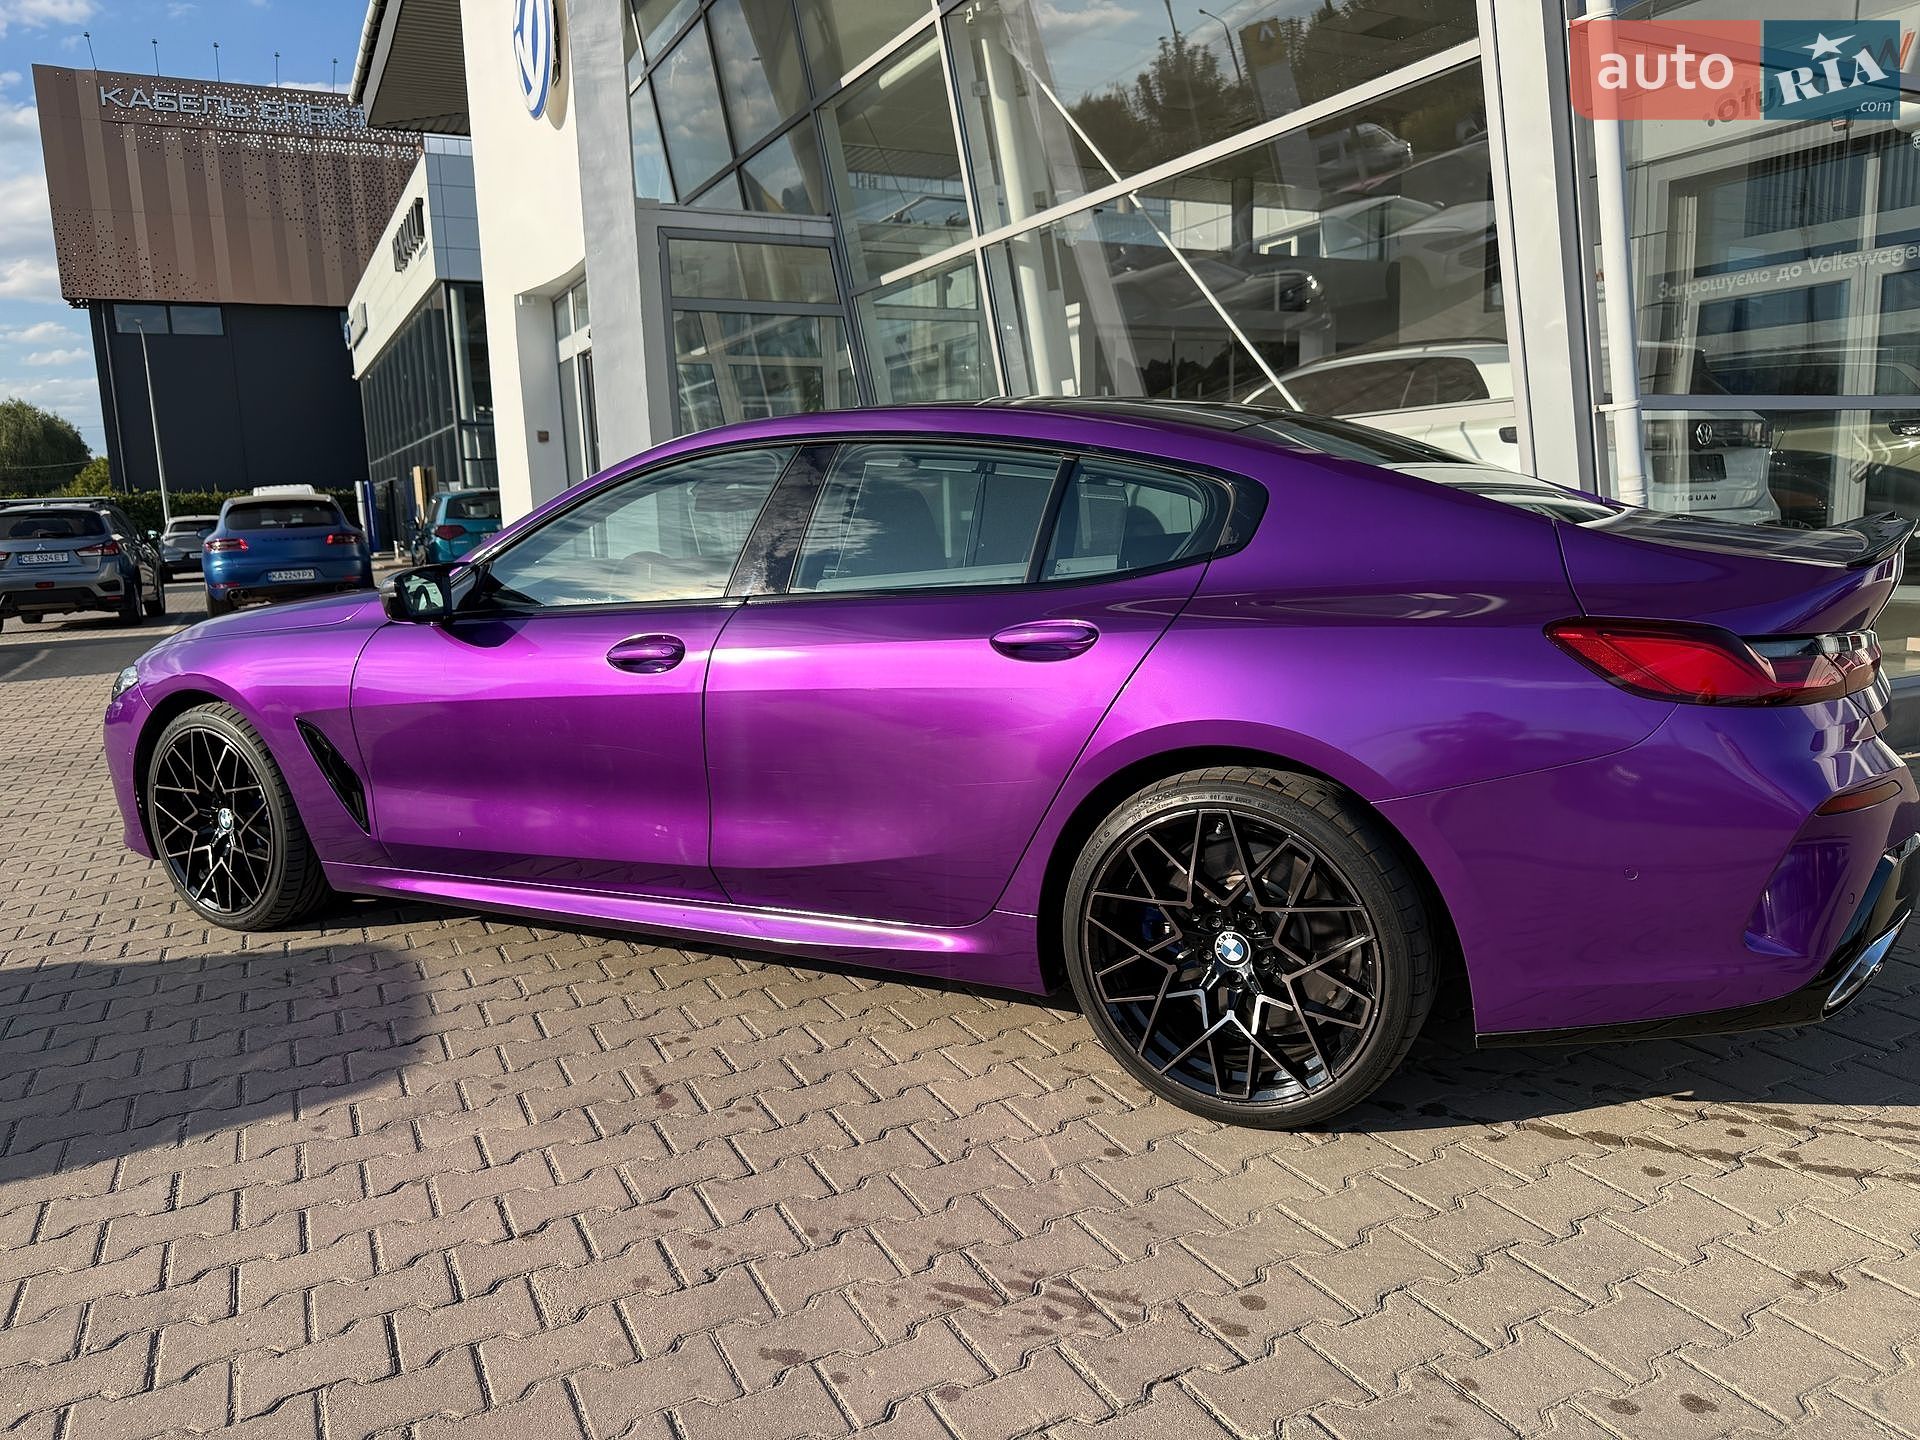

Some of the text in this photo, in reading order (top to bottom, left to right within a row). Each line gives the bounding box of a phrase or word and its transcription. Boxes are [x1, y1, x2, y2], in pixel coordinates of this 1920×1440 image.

[100, 85, 250, 118] КАБЕЛЬ
[1657, 244, 1920, 300] Запрошуємо до Volkswage
[1673, 494, 1718, 502] TIGUAN
